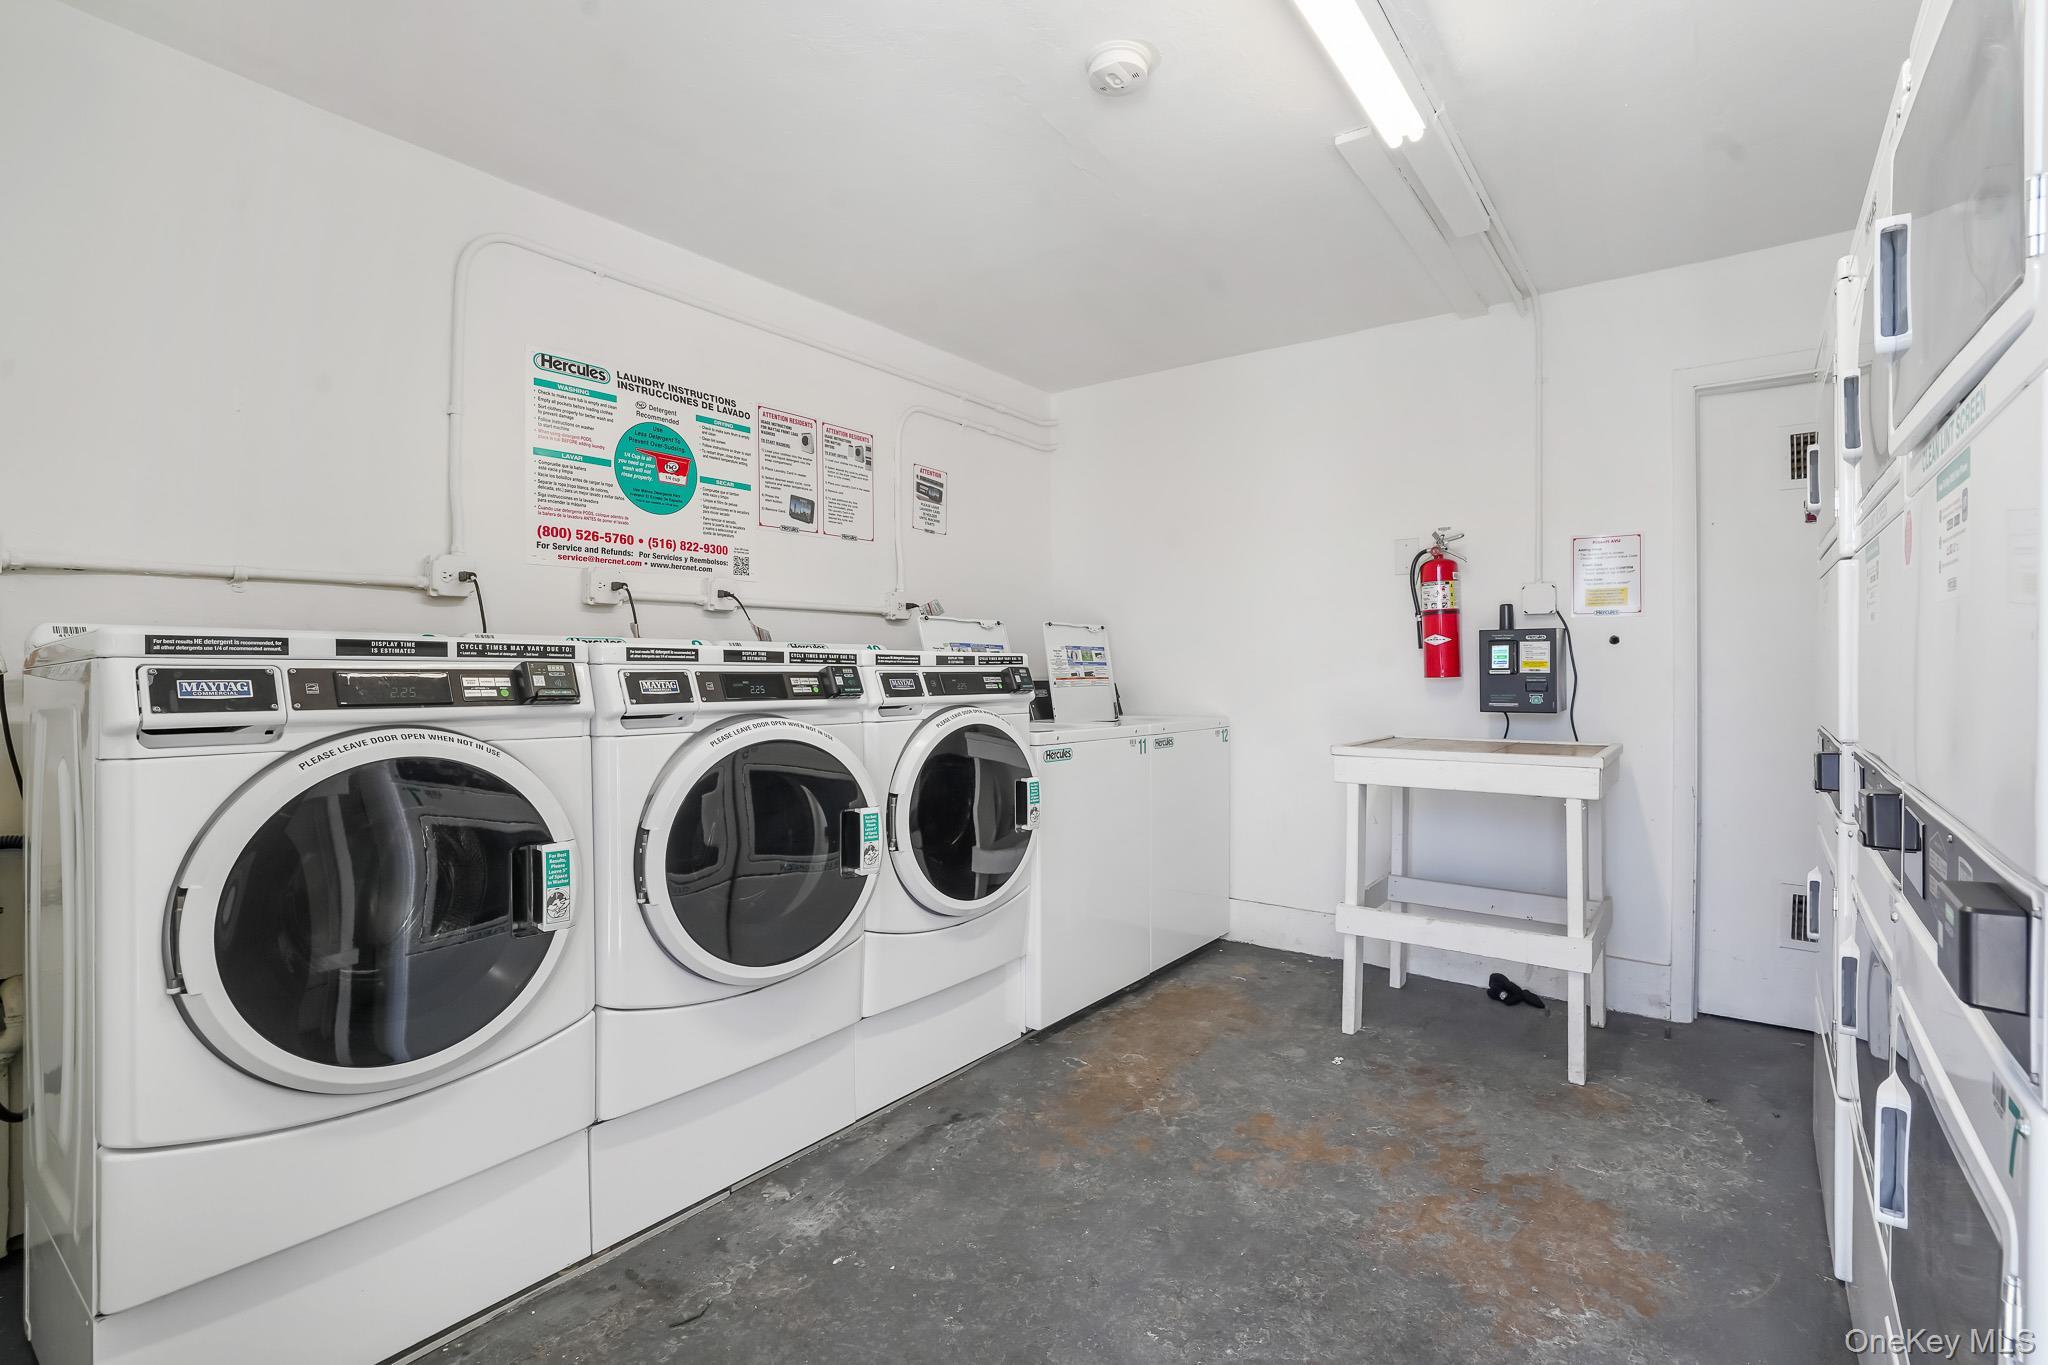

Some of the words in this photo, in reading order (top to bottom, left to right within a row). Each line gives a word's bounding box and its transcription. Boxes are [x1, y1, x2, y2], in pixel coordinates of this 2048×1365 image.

[541, 353, 606, 380] Hercules
[557, 384, 590, 396] WASHING
[617, 371, 664, 389] LAUNDRY
[668, 384, 736, 407] INSTRUCTIONS
[617, 381, 698, 407] INSTRUCCIONES
[701, 402, 714, 410] DE
[717, 405, 750, 420] LAVADO
[586, 406, 599, 414] loading
[649, 405, 677, 416] Detergent
[636, 411, 679, 425] Recommended
[763, 412, 788, 423] ATTENTION
[789, 418, 813, 428] RESIDENTS
[826, 428, 848, 437] ATTENTION
[849, 433, 870, 443] RESIDENTS
[1921, 432, 1940, 472] CLEAN
[1940, 418, 1955, 455] LINT
[1955, 387, 1985, 439] SCREEN
[562, 453, 582, 461] LAVAR
[920, 468, 941, 478] ATTENTION
[537, 525, 571, 541] (800)
[576, 529, 634, 545] 526-5760
[648, 537, 676, 552] (516)
[680, 541, 728, 555] 822-9300
[537, 541, 550, 549] For
[552, 543, 582, 552] Service
[601, 547, 633, 557] Refunds:
[558, 554, 642, 566] service@hercnet.com
[650, 561, 712, 572] www.hercnet.com
[653, 553, 684, 562] Servicios
[690, 557, 728, 566] Reembolsos:
[181, 682, 248, 692] MAYTAG
[936, 718, 951, 728] PLEASE
[710, 732, 732, 747] PLEASE
[733, 725, 752, 735] LEAVE
[1221, 728, 1229, 743] 12
[1139, 738, 1147, 755] 11
[1154, 738, 1173, 748] Hercules
[298, 749, 337, 770] PLEASE
[337, 740, 368, 754] LEAVE
[370, 734, 398, 745] DOOR
[428, 733, 454, 743] WHEN
[457, 738, 474, 747] NOT
[486, 746, 500, 758] USE
[1045, 749, 1072, 760] Hercules
